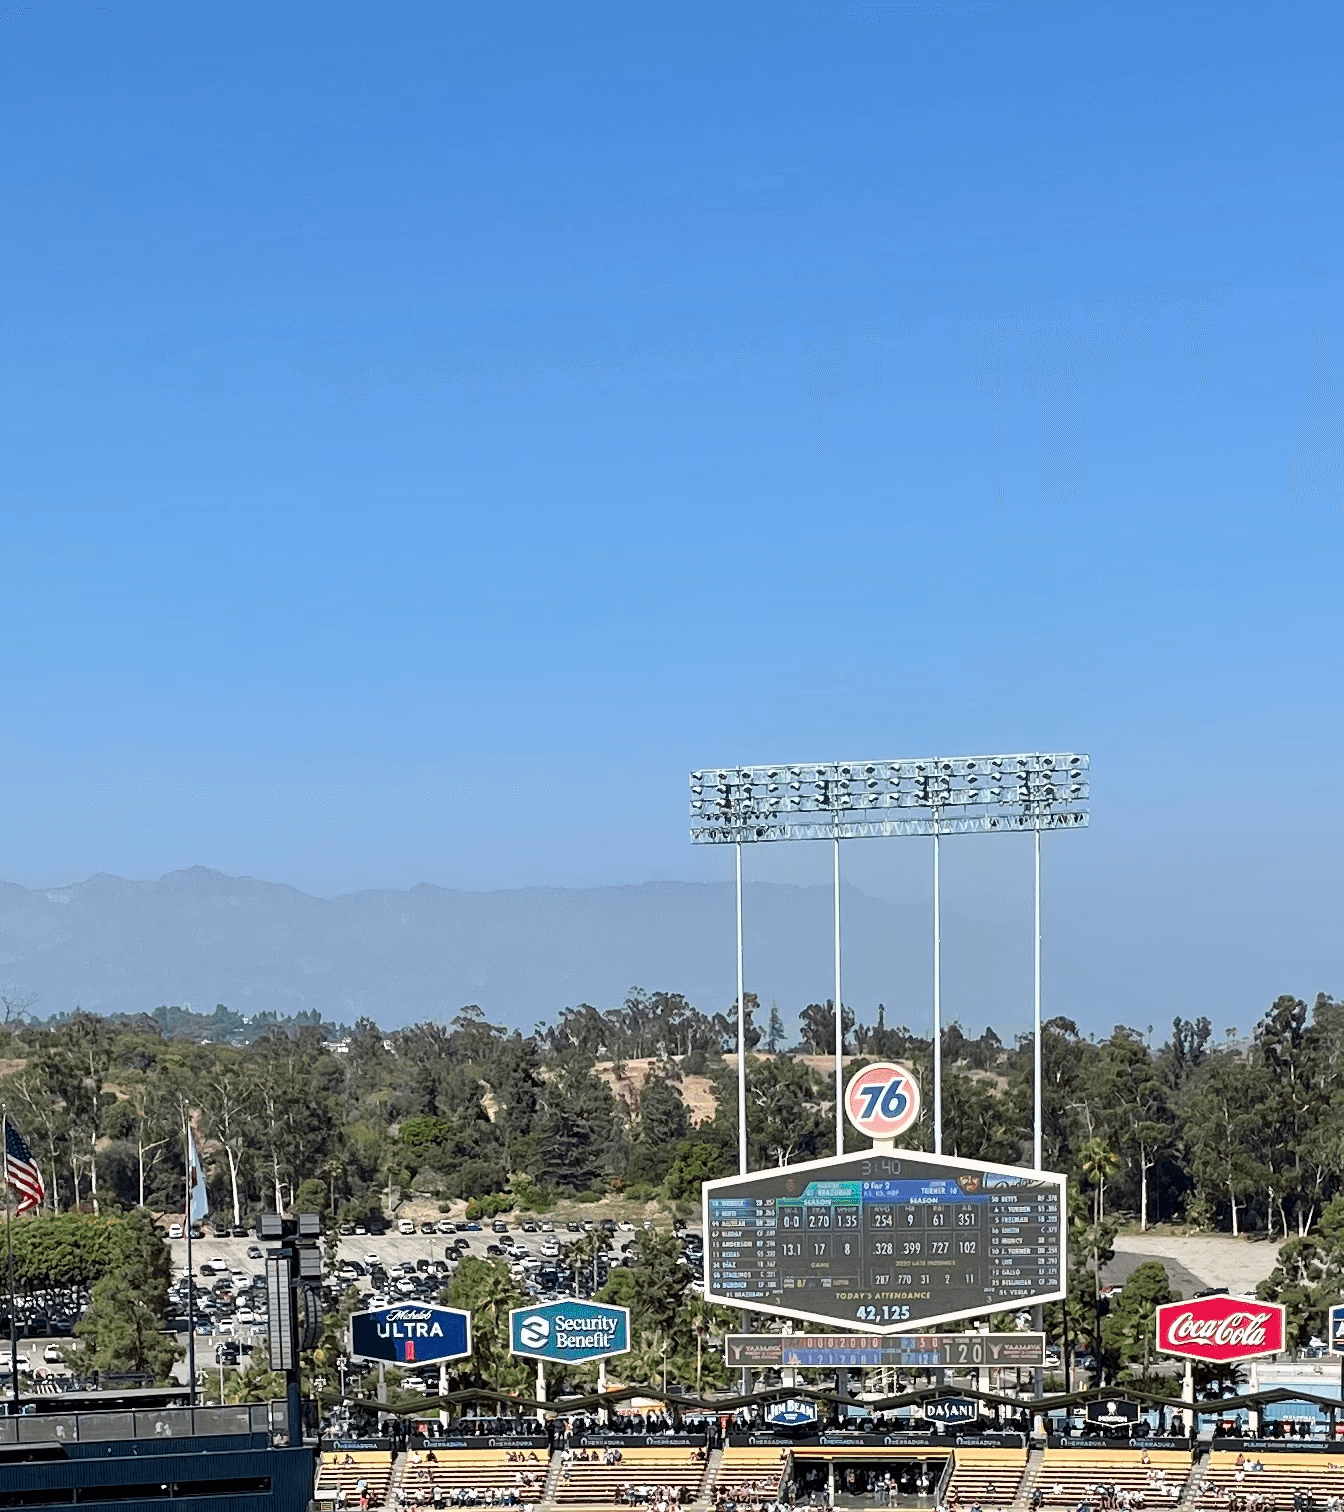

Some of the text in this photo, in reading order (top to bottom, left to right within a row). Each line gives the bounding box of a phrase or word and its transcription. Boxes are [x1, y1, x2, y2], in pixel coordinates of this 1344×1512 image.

[859, 1079, 908, 1120] 76
[861, 1160, 902, 1175] 3:40
[910, 1197, 939, 1205] SEASON
[1001, 1195, 1018, 1203] BETTS
[783, 1215, 857, 1228] 0-0 2.70 1.35
[872, 1213, 975, 1227] .254 9 61 351
[782, 1243, 851, 1256] 13.1 17 8
[873, 1241, 976, 1255] .328 .399 .727 102
[920, 1273, 974, 1285] 31 2 11
[836, 1291, 931, 1301] TODAY'S ATTENDANCE
[386, 1309, 432, 1322] Michelob
[856, 1305, 910, 1321] 42,125
[377, 1321, 444, 1338] ULTRA
[555, 1316, 618, 1333] Security
[1168, 1312, 1273, 1346] Coca-Cola
[556, 1333, 612, 1348] Benefit
[807, 1337, 813, 1348] 0
[817, 1337, 823, 1348] 0
[827, 1337, 834, 1348] 0
[840, 1337, 846, 1348] 2
[850, 1337, 856, 1348] 0
[860, 1337, 867, 1348] 0
[872, 1337, 879, 1348] 0
[919, 1338, 926, 1348] 5
[944, 1344, 951, 1363] 1
[958, 1344, 968, 1363] 2
[972, 1344, 982, 1363] 0
[768, 1401, 814, 1419] JIM BEAM
[928, 1405, 974, 1418] DASANI
